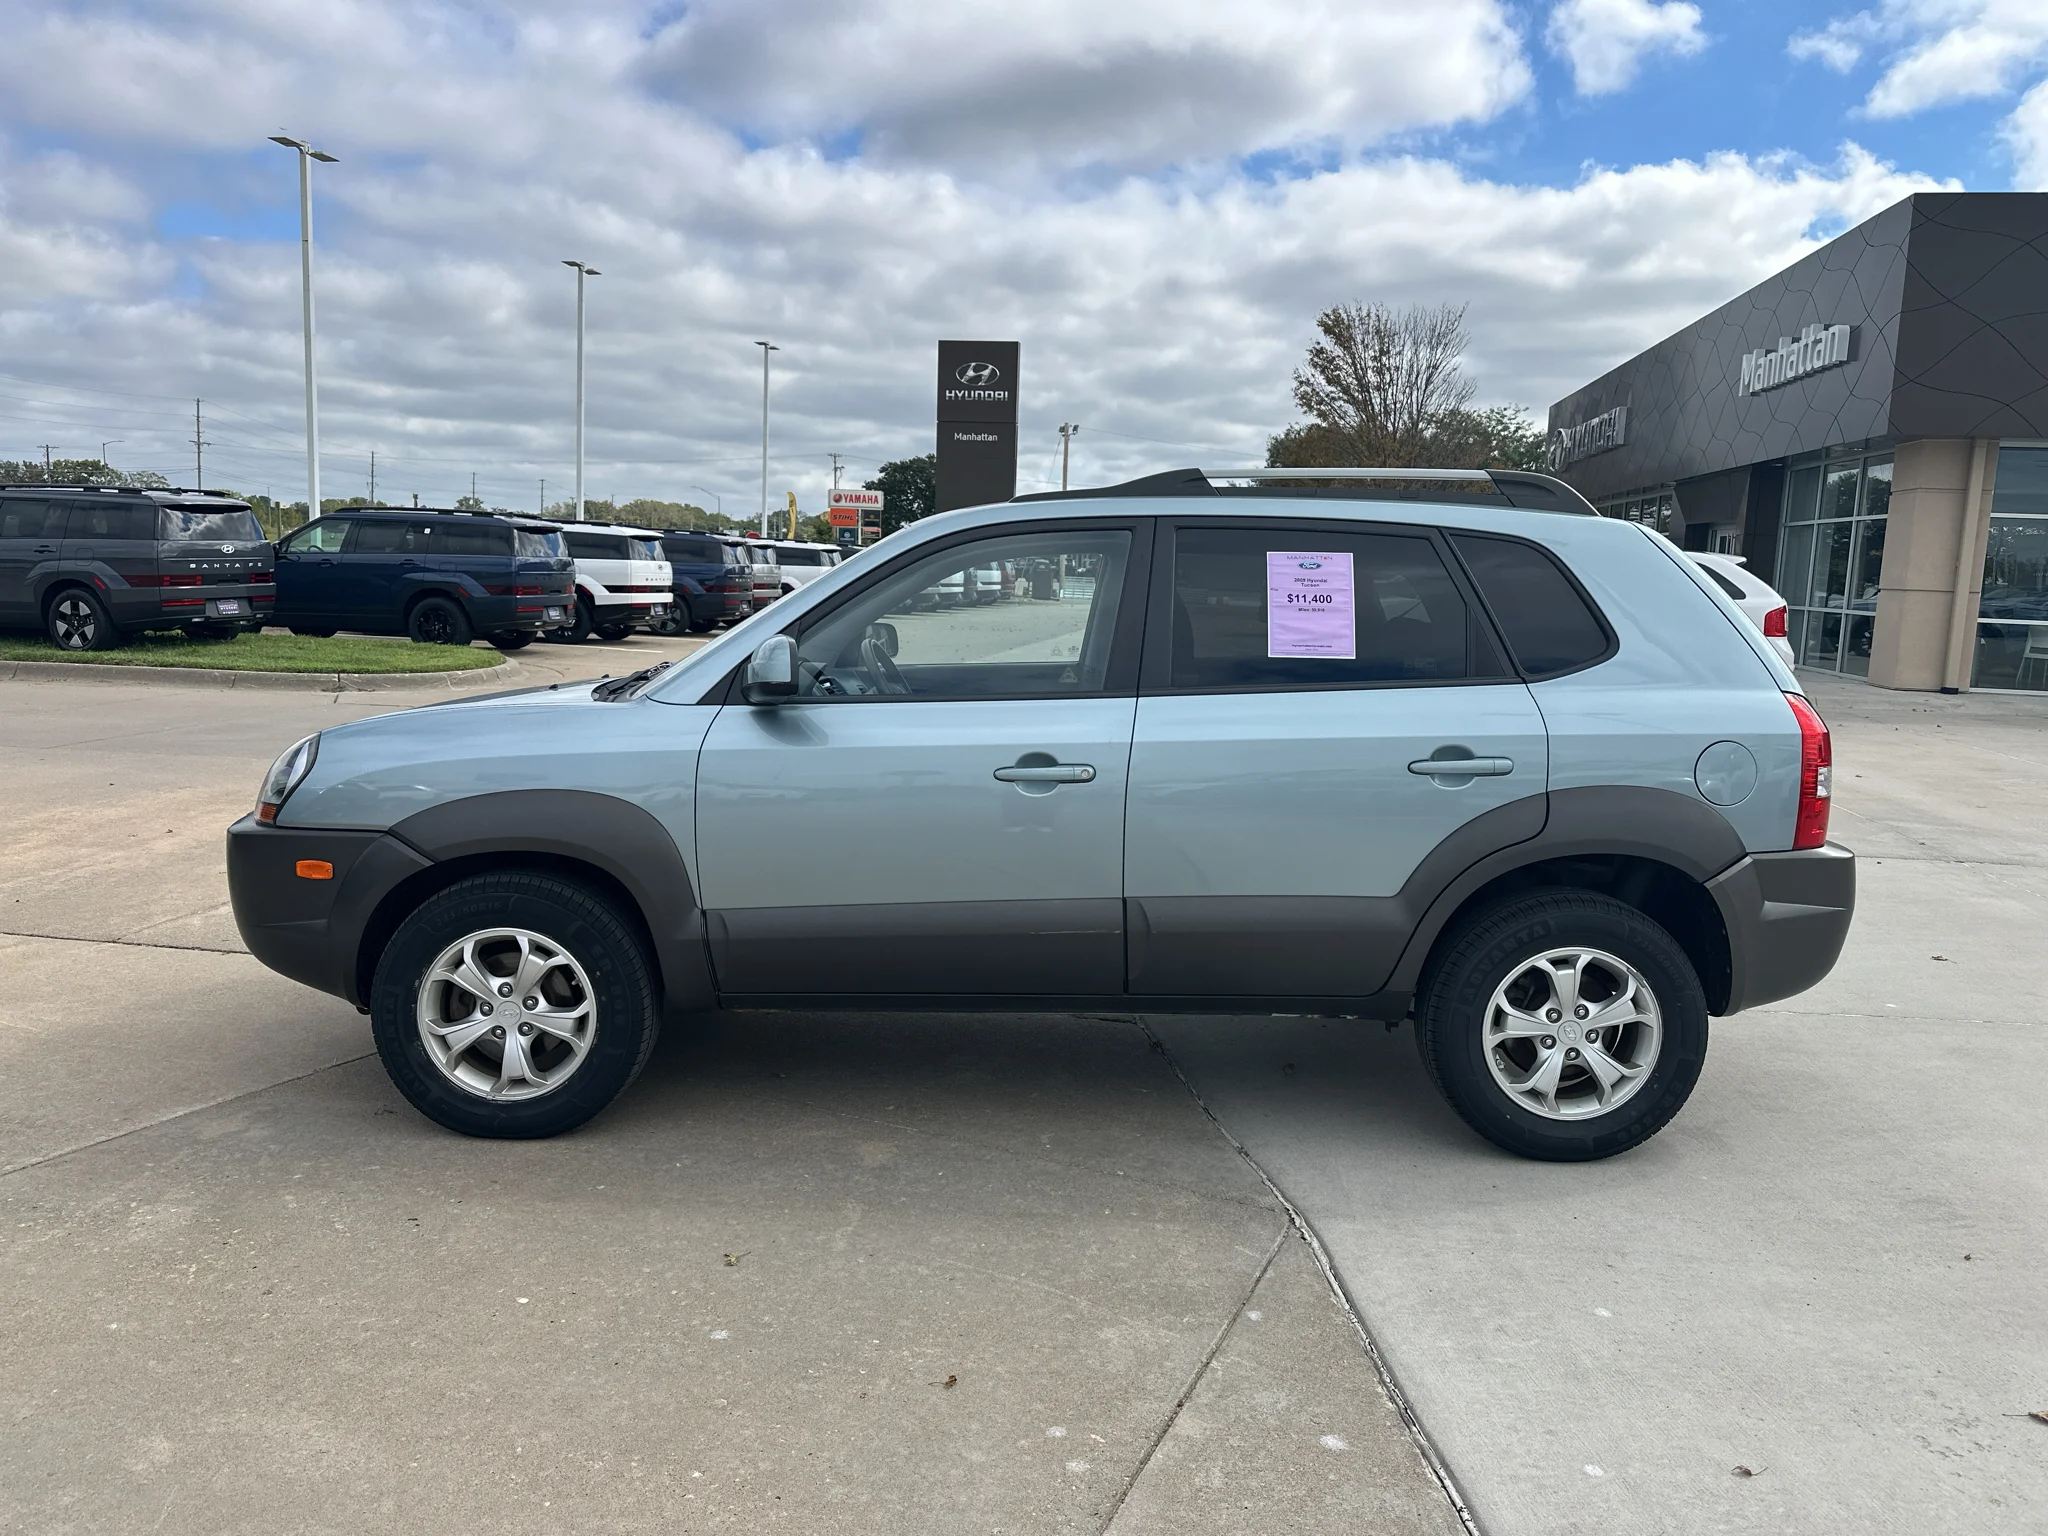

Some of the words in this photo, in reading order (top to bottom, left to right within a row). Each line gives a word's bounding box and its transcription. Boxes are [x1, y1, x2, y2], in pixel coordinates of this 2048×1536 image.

[1739, 324, 1850, 397] Manhattan
[945, 389, 1008, 401] HYUNDAI
[954, 432, 998, 441] Manhattan
[843, 493, 879, 504] YAMAHA
[1302, 561, 1318, 569] Ford
[1287, 593, 1333, 605] $11,400
[1462, 924, 1548, 1000] ADVANTA
